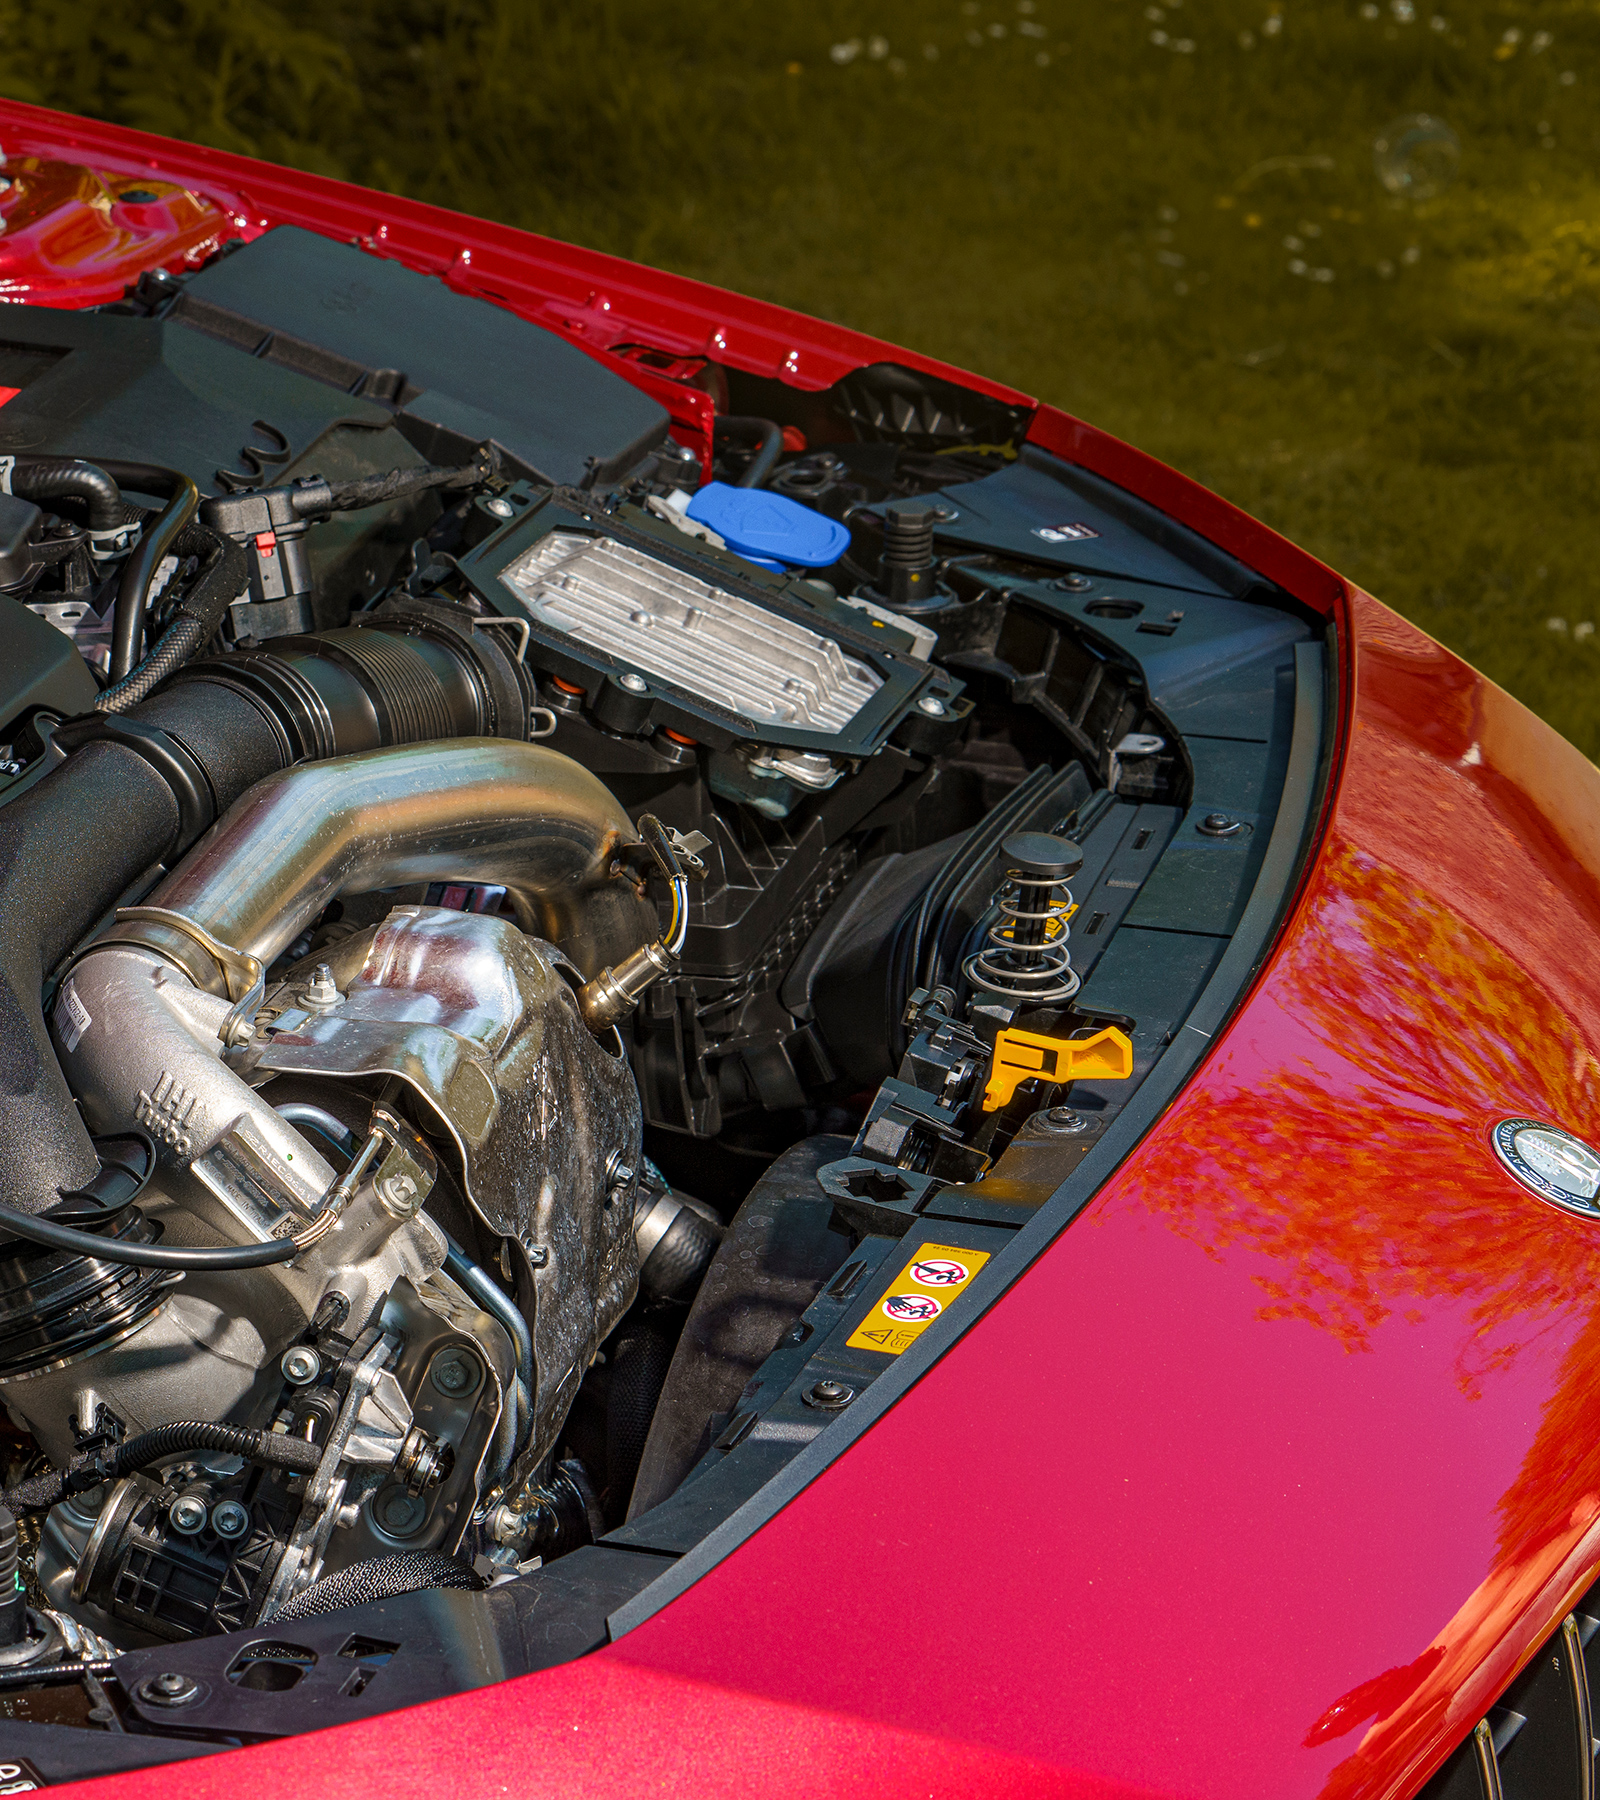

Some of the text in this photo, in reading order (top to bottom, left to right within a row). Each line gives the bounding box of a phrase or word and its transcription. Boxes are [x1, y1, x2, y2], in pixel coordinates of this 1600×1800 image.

[153, 1070, 202, 1128] IHI
[1499, 1120, 1542, 1166] AFFALTERBACH
[226, 1184, 240, 1201] MADE
